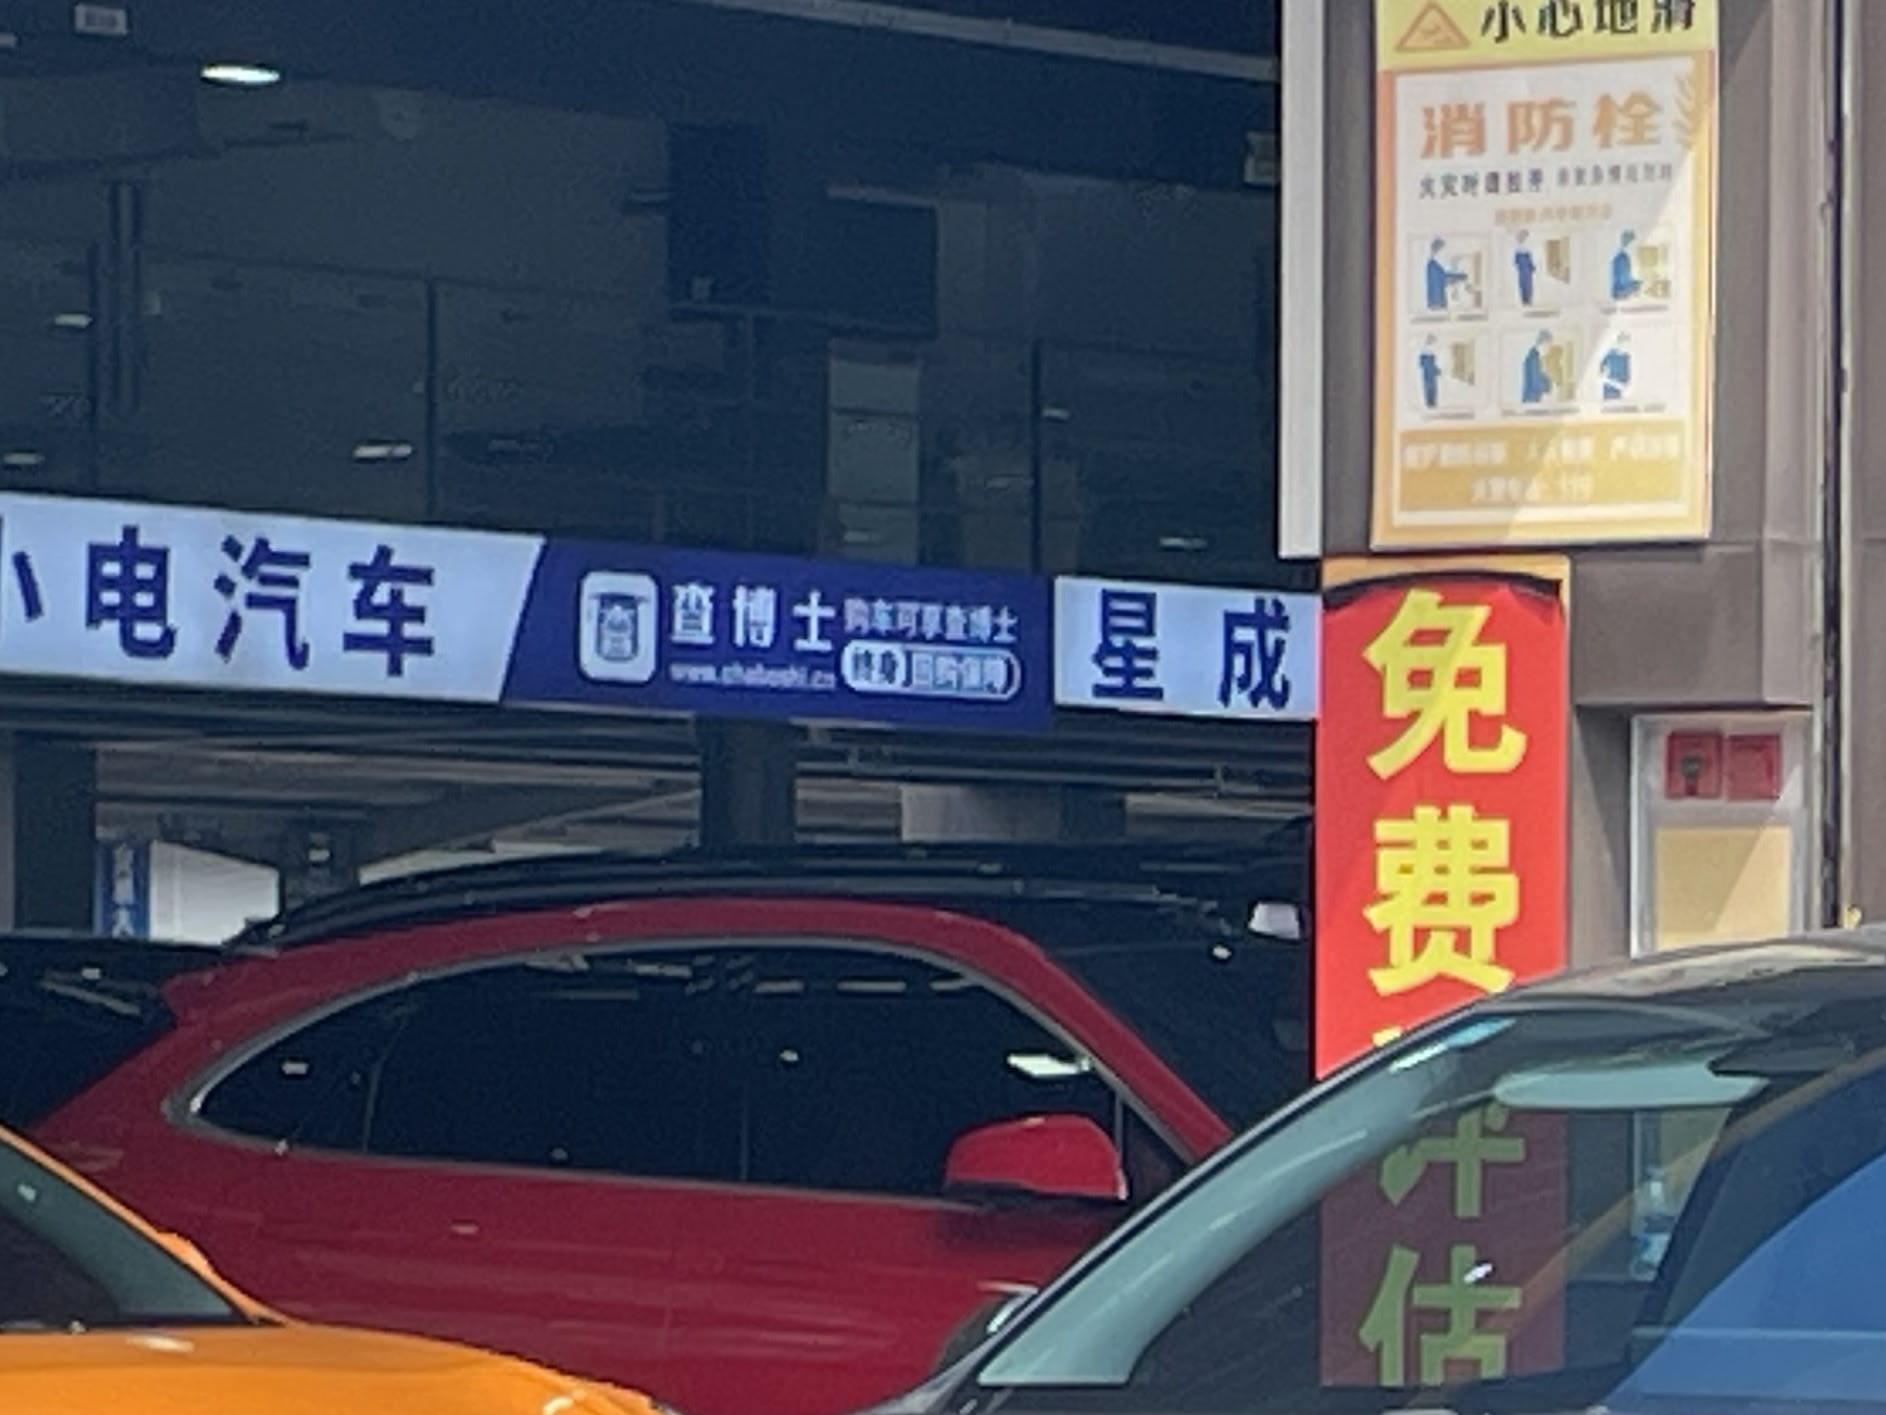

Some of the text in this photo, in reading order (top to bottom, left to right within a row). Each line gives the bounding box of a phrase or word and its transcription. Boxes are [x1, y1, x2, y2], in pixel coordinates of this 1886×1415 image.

[1419, 91, 1664, 160] 消防栓
[670, 582, 836, 652] 查博士
[1091, 588, 1290, 711] 星成
